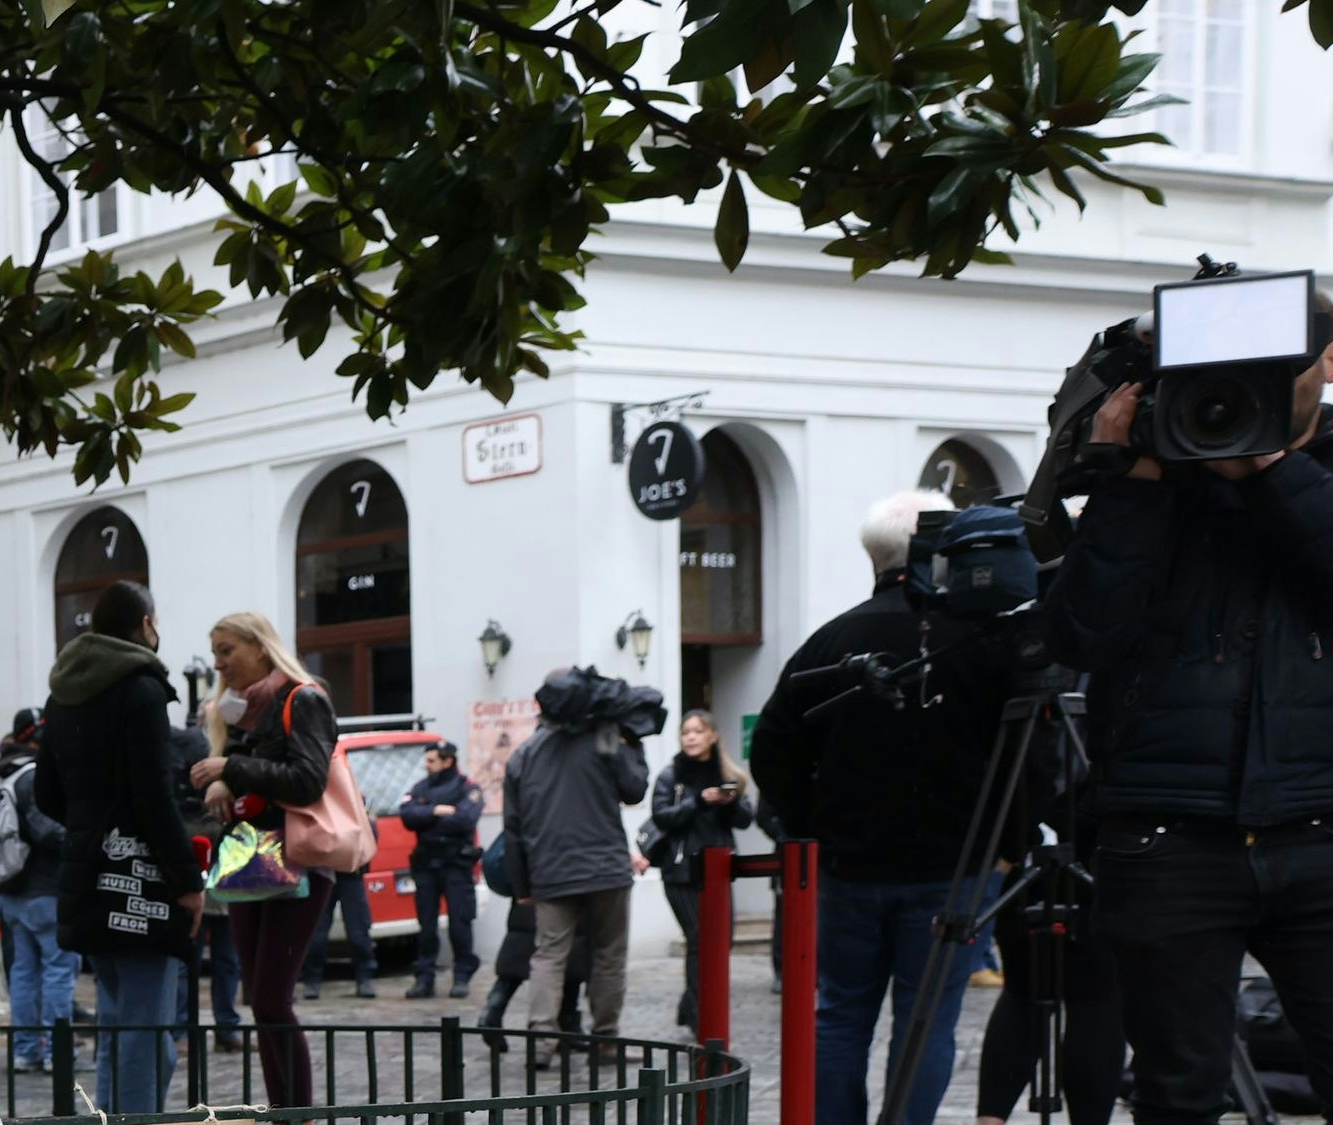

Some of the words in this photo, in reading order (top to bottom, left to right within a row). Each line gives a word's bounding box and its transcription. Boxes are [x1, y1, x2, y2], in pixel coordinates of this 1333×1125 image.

[638, 479, 687, 503] JOE'S
[701, 552, 736, 568] BEER
[348, 574, 375, 590] GIN
[113, 916, 148, 931] FROM
